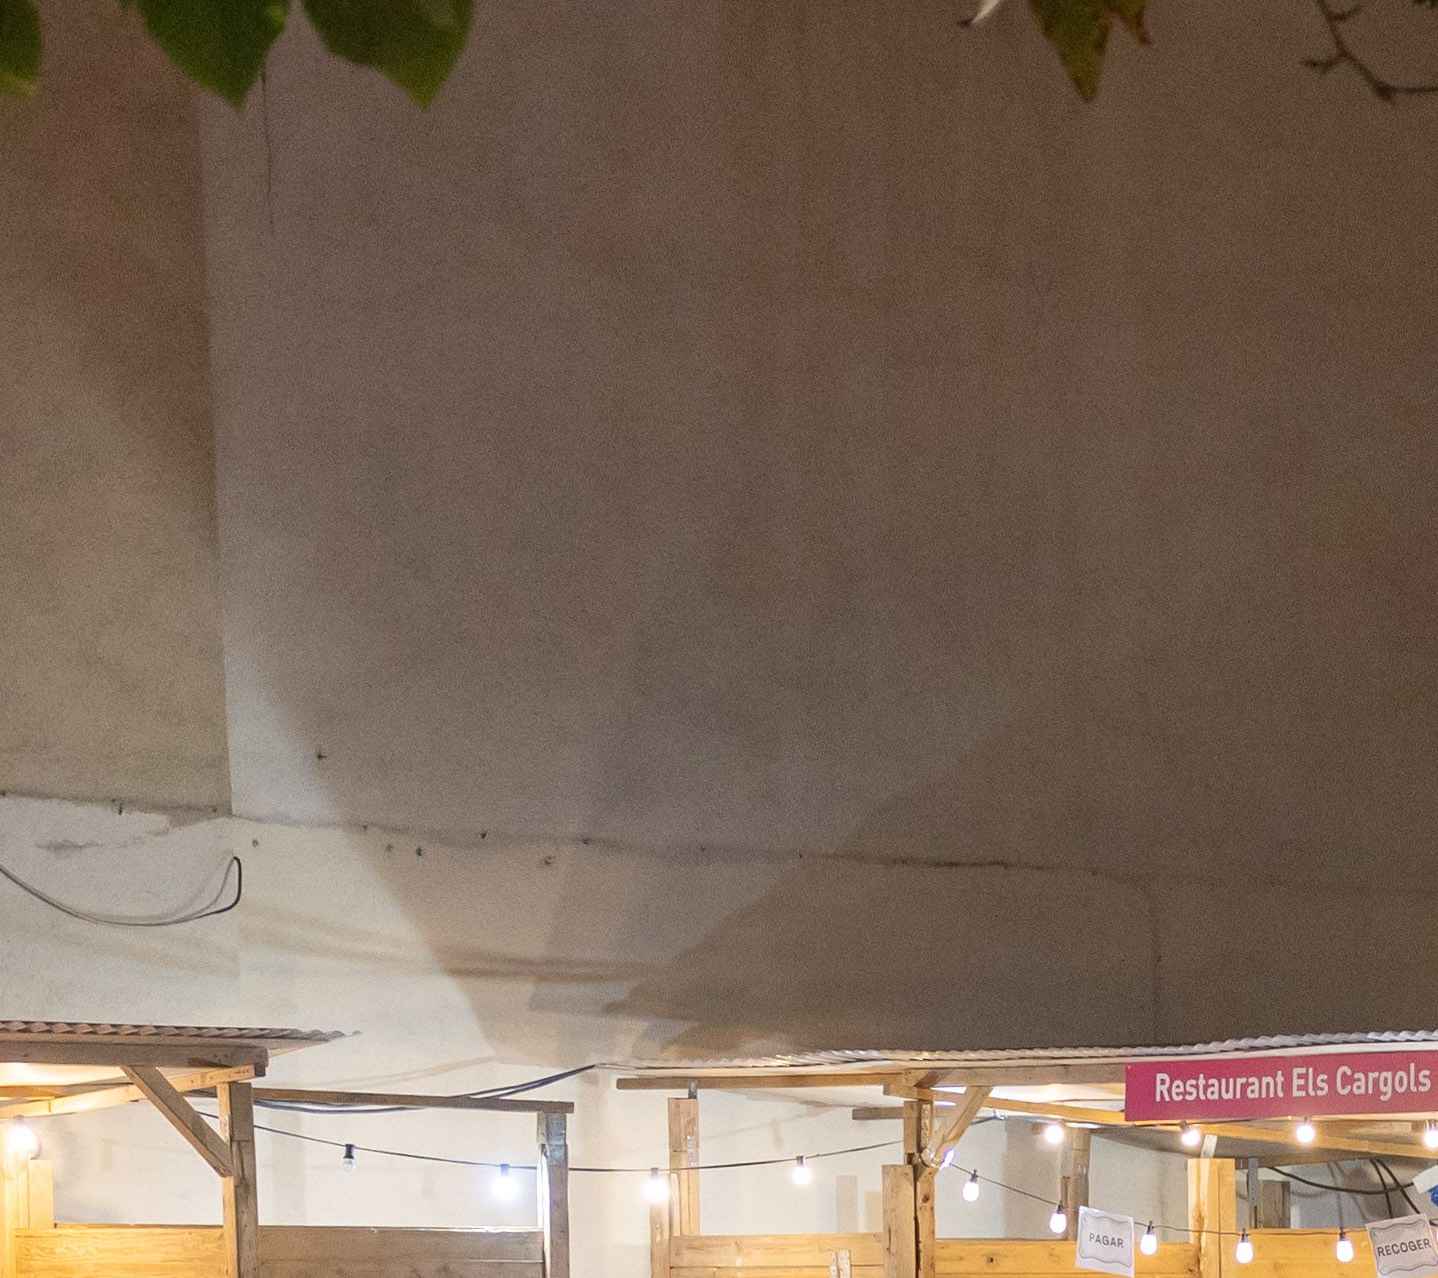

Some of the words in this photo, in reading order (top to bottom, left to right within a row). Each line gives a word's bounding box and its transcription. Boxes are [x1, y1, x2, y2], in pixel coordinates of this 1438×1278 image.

[1155, 1066, 1285, 1102] Restaurant
[1292, 1066, 1329, 1098] Els
[1336, 1062, 1432, 1101] Cargols
[1089, 1232, 1124, 1249] PAGAR
[1377, 1238, 1433, 1257] RECOGER
